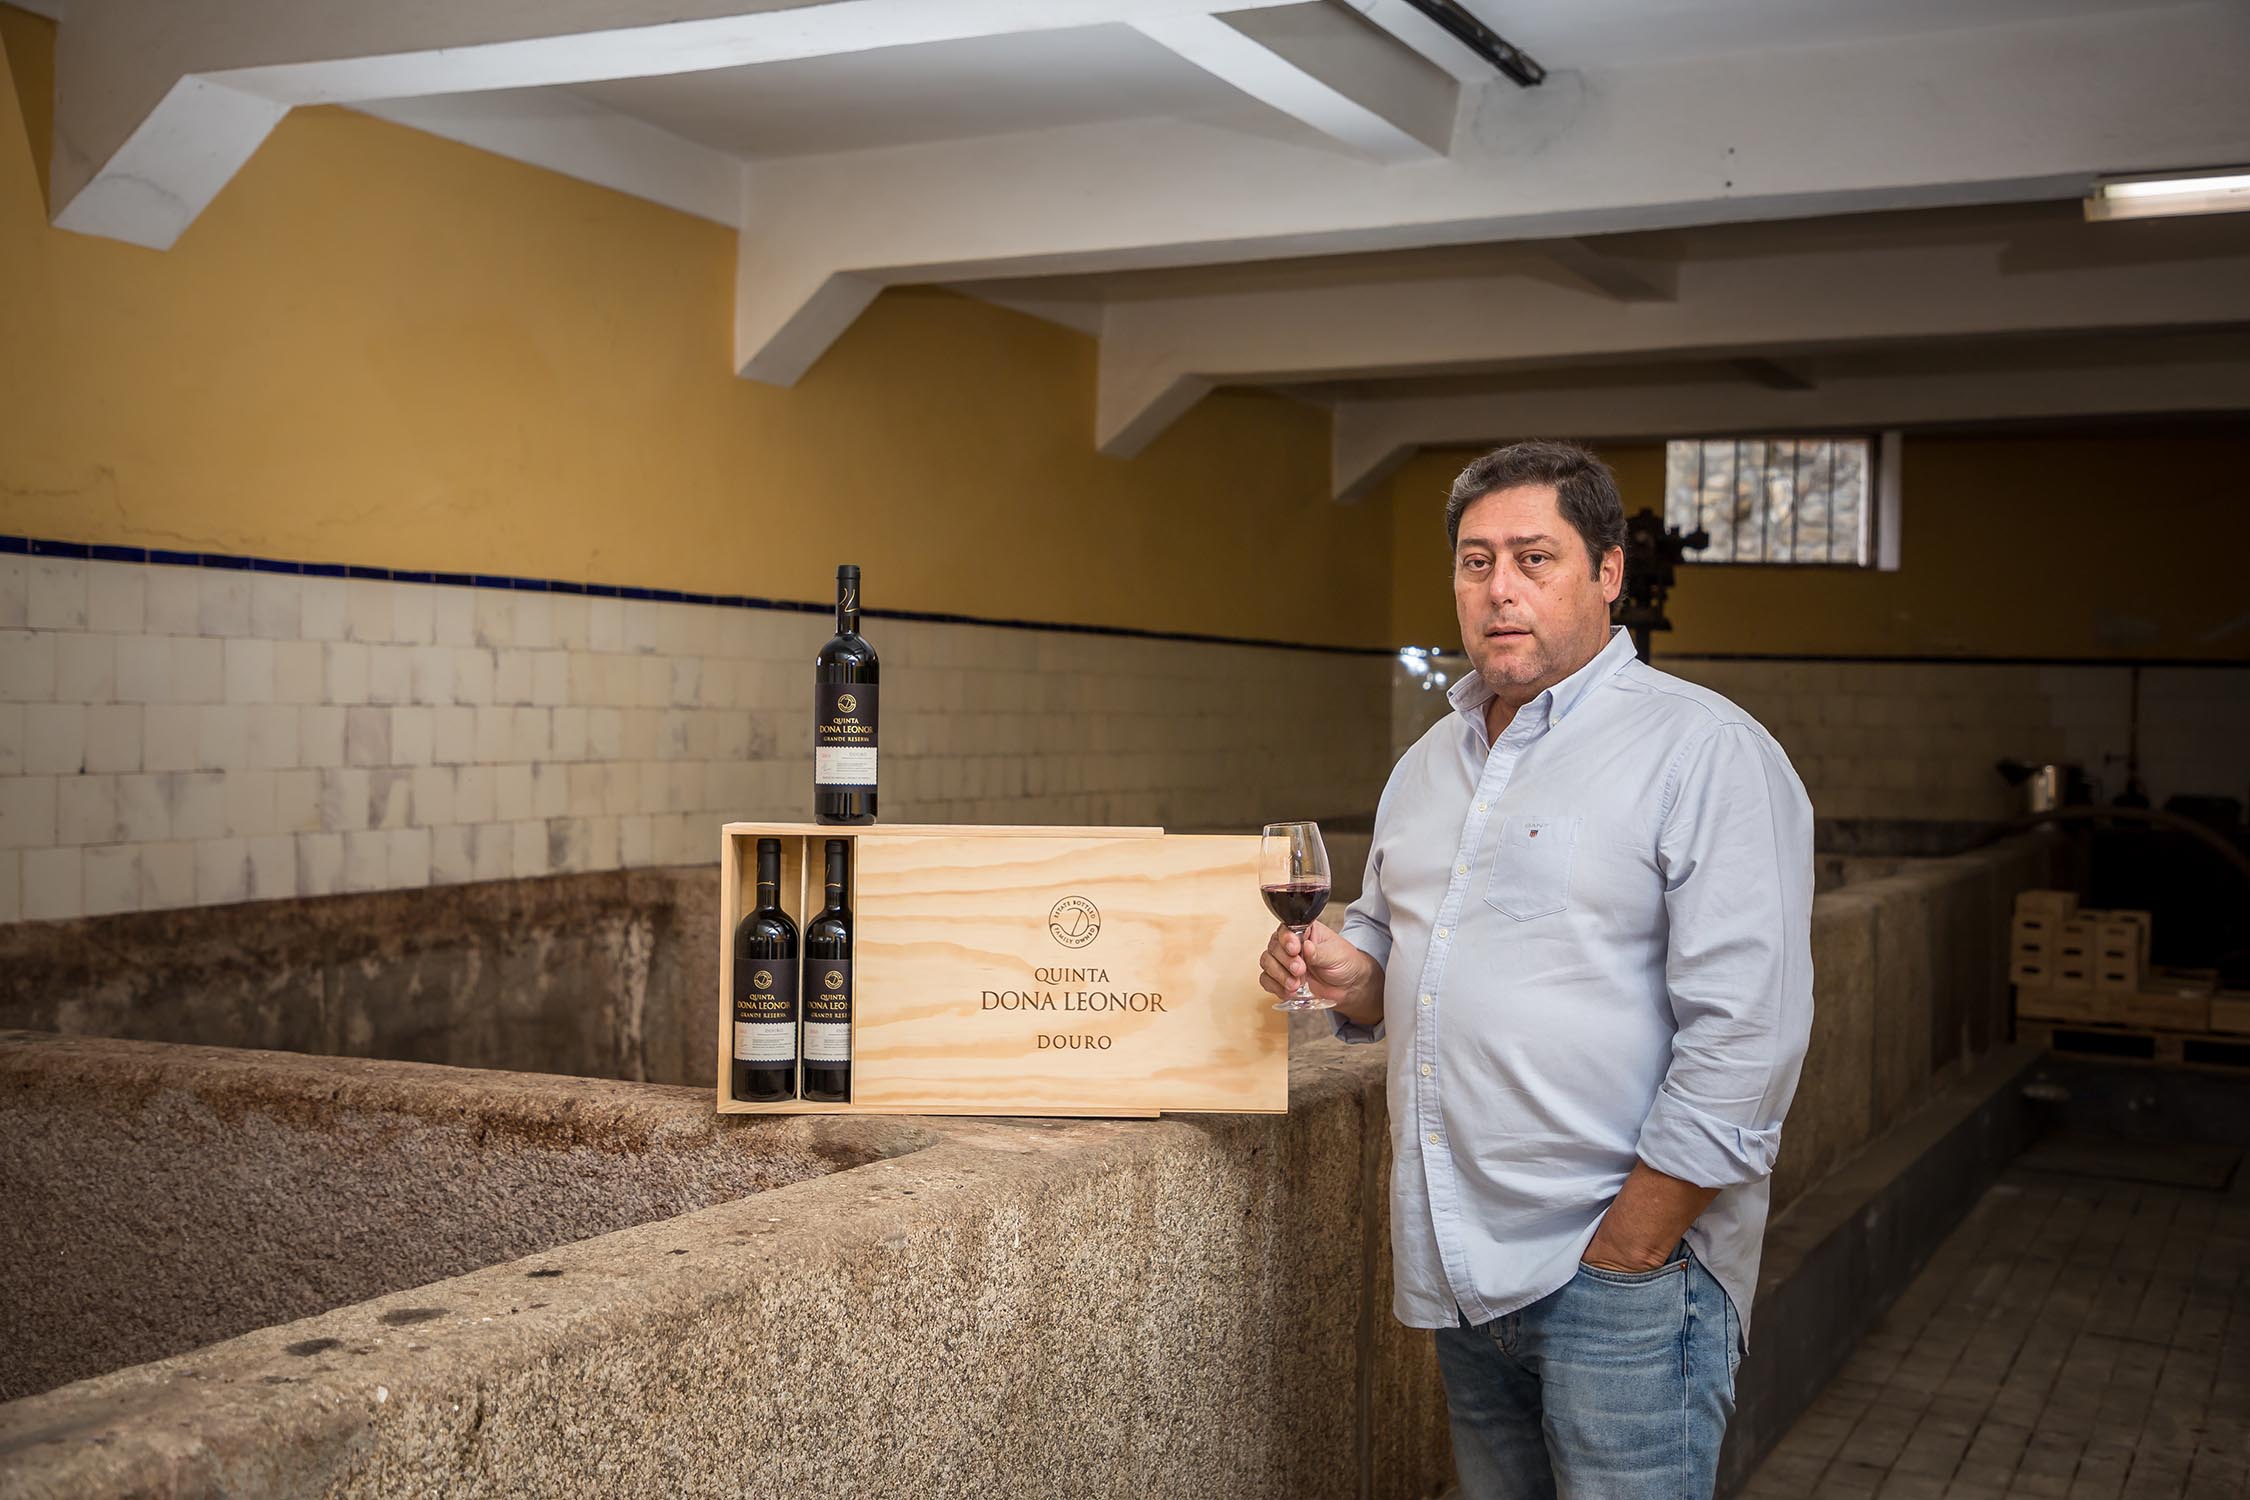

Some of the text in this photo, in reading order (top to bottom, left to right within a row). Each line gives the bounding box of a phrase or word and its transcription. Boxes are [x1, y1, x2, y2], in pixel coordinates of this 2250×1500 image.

[819, 725, 841, 733] DONA
[833, 717, 859, 725] QUINTA
[1053, 900, 1096, 919] ESTATE BOTTLED
[1054, 927, 1096, 945] FAMILY OWNED
[1034, 967, 1110, 985] QUINTA
[737, 1001, 757, 1009] DONA
[808, 1001, 829, 1009] DONA
[981, 990, 1168, 1013] DONA LEONOR
[1037, 1034, 1112, 1050] DOURO
